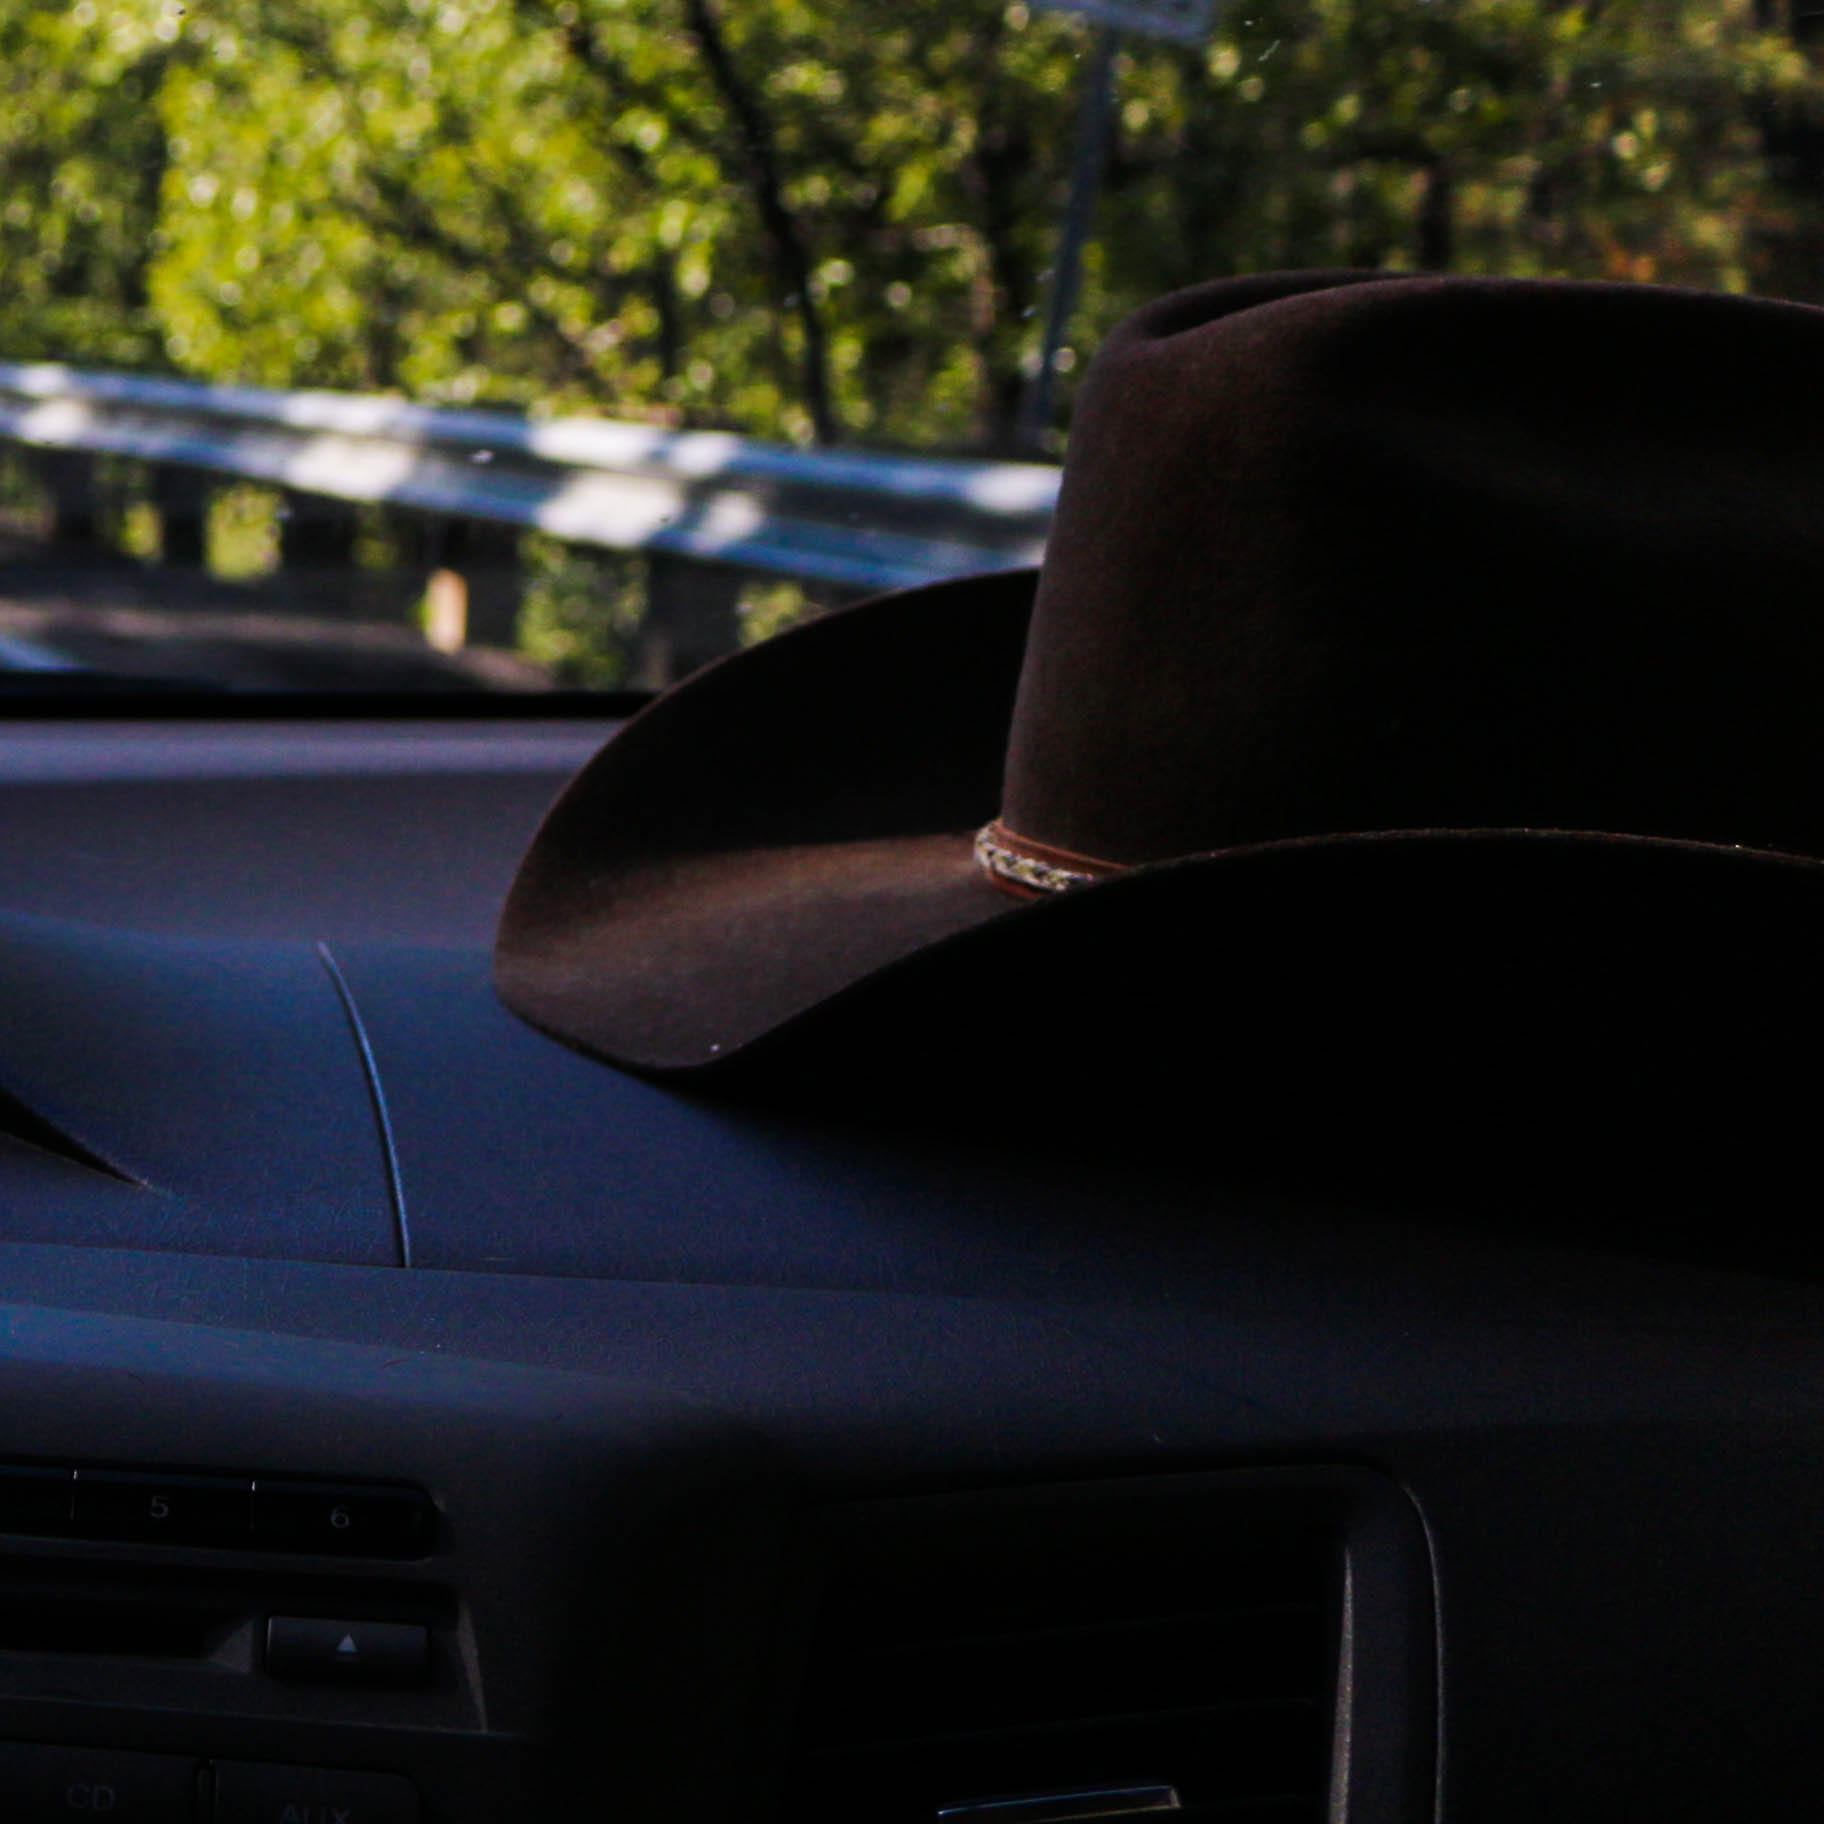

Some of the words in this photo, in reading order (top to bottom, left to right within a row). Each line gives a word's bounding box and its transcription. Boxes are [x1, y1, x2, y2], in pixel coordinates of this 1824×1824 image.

[148, 1493, 172, 1521] 5
[328, 1503, 353, 1530] 6
[64, 1782, 117, 1811] CD
